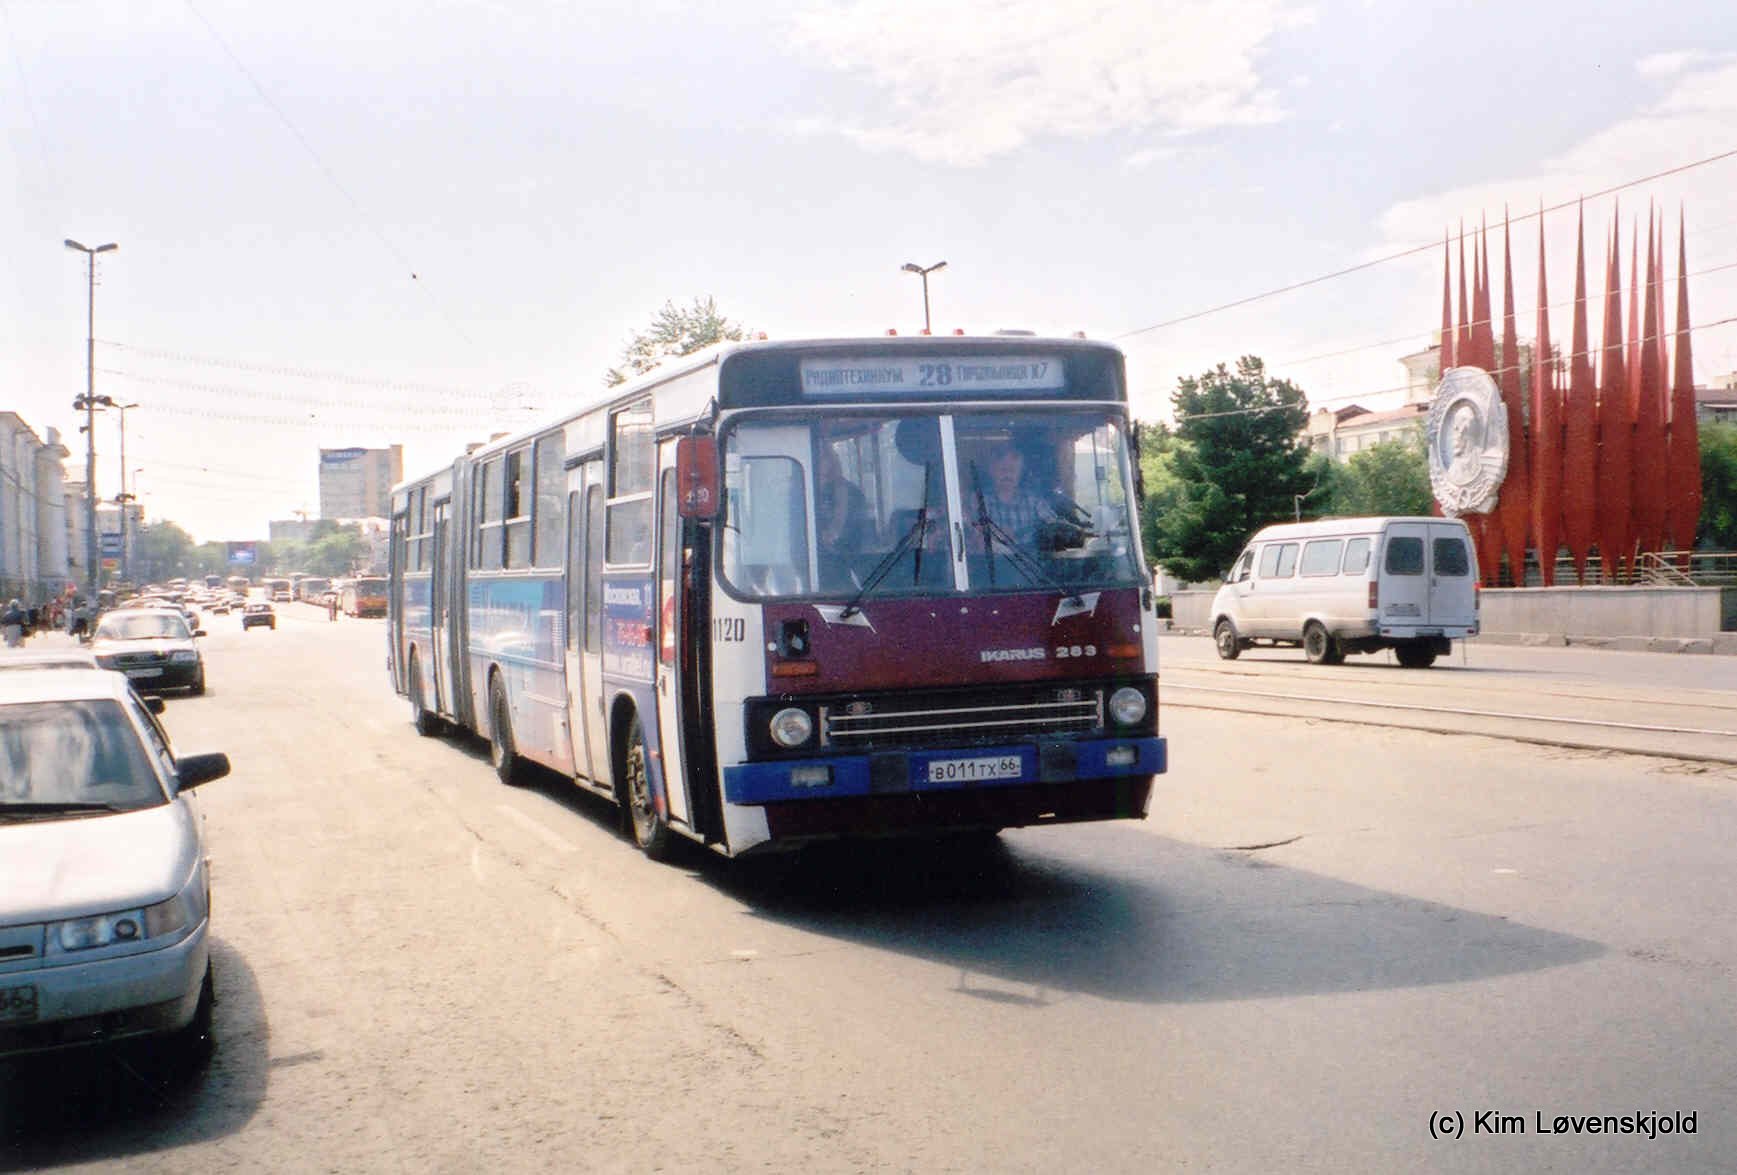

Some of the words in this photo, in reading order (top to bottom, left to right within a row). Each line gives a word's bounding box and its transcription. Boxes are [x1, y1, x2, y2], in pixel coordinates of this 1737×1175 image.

[919, 363, 953, 386] 28
[713, 618, 746, 643] 1120
[980, 647, 1046, 663] IKARUS
